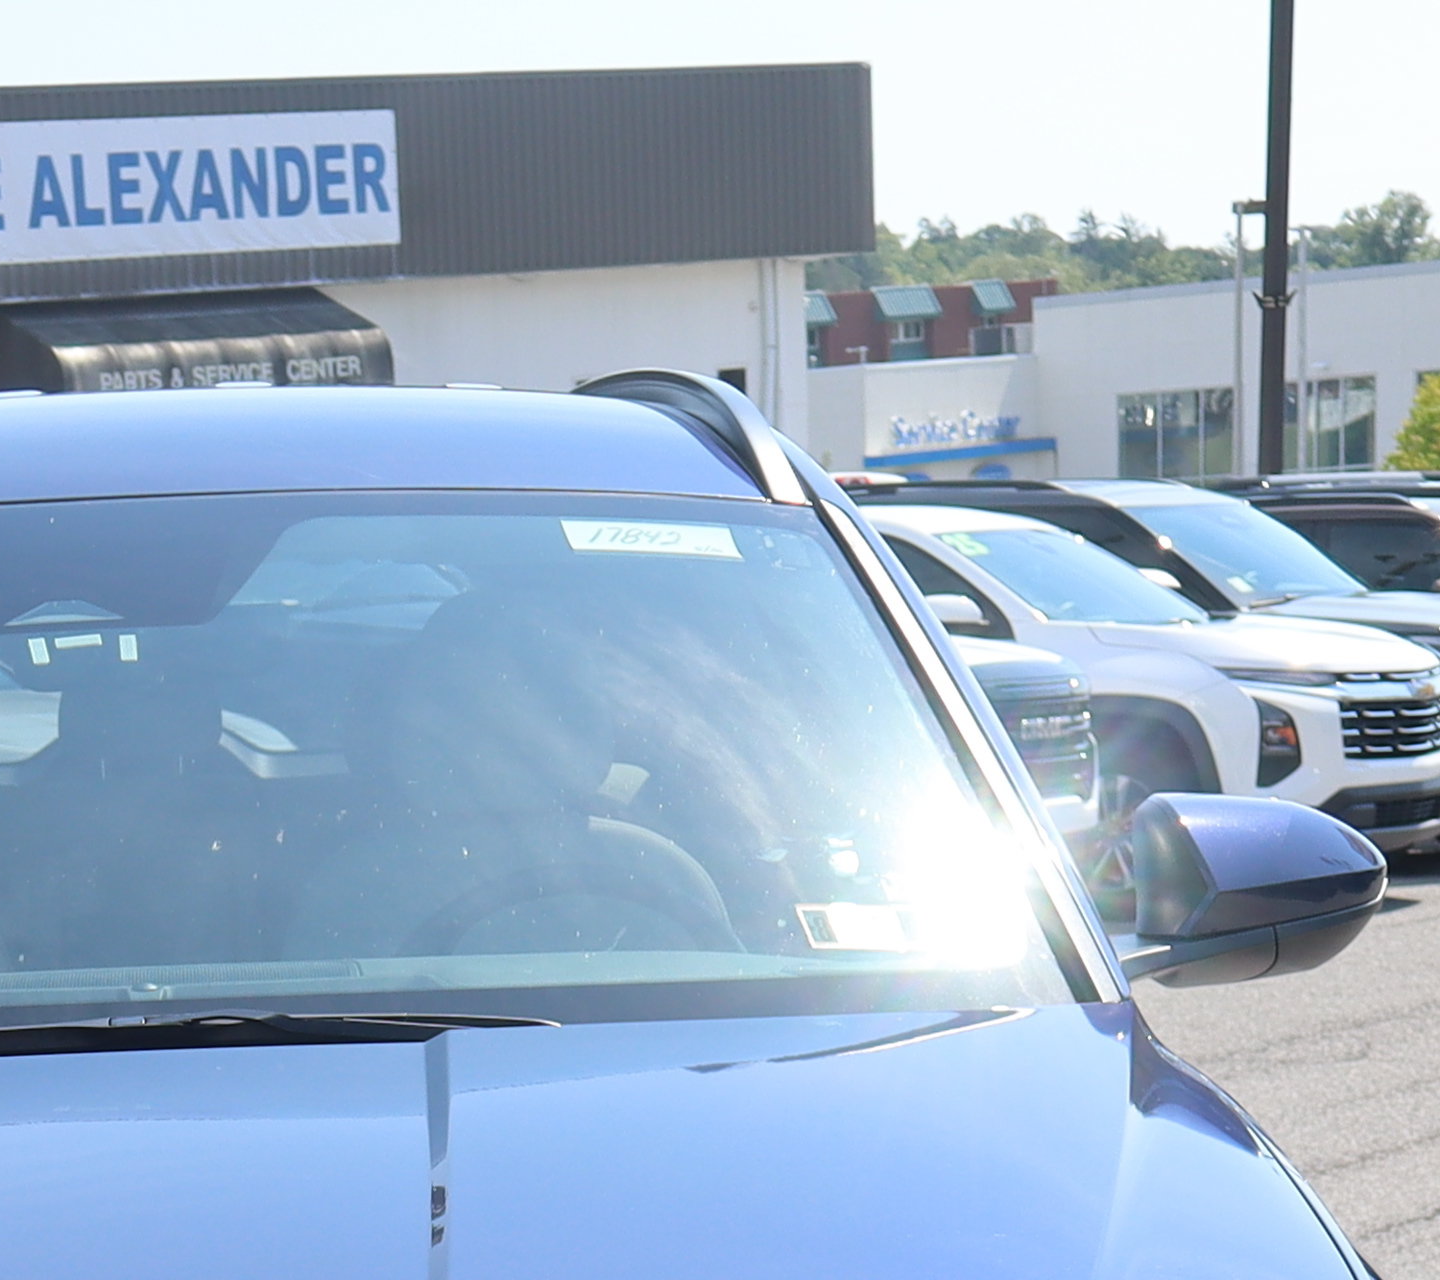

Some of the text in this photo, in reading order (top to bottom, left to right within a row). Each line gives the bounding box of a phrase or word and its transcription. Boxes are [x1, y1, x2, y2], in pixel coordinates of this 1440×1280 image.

[28, 142, 392, 229] ALEXANDER
[99, 355, 362, 391] PARTS & SERVICE CENTER
